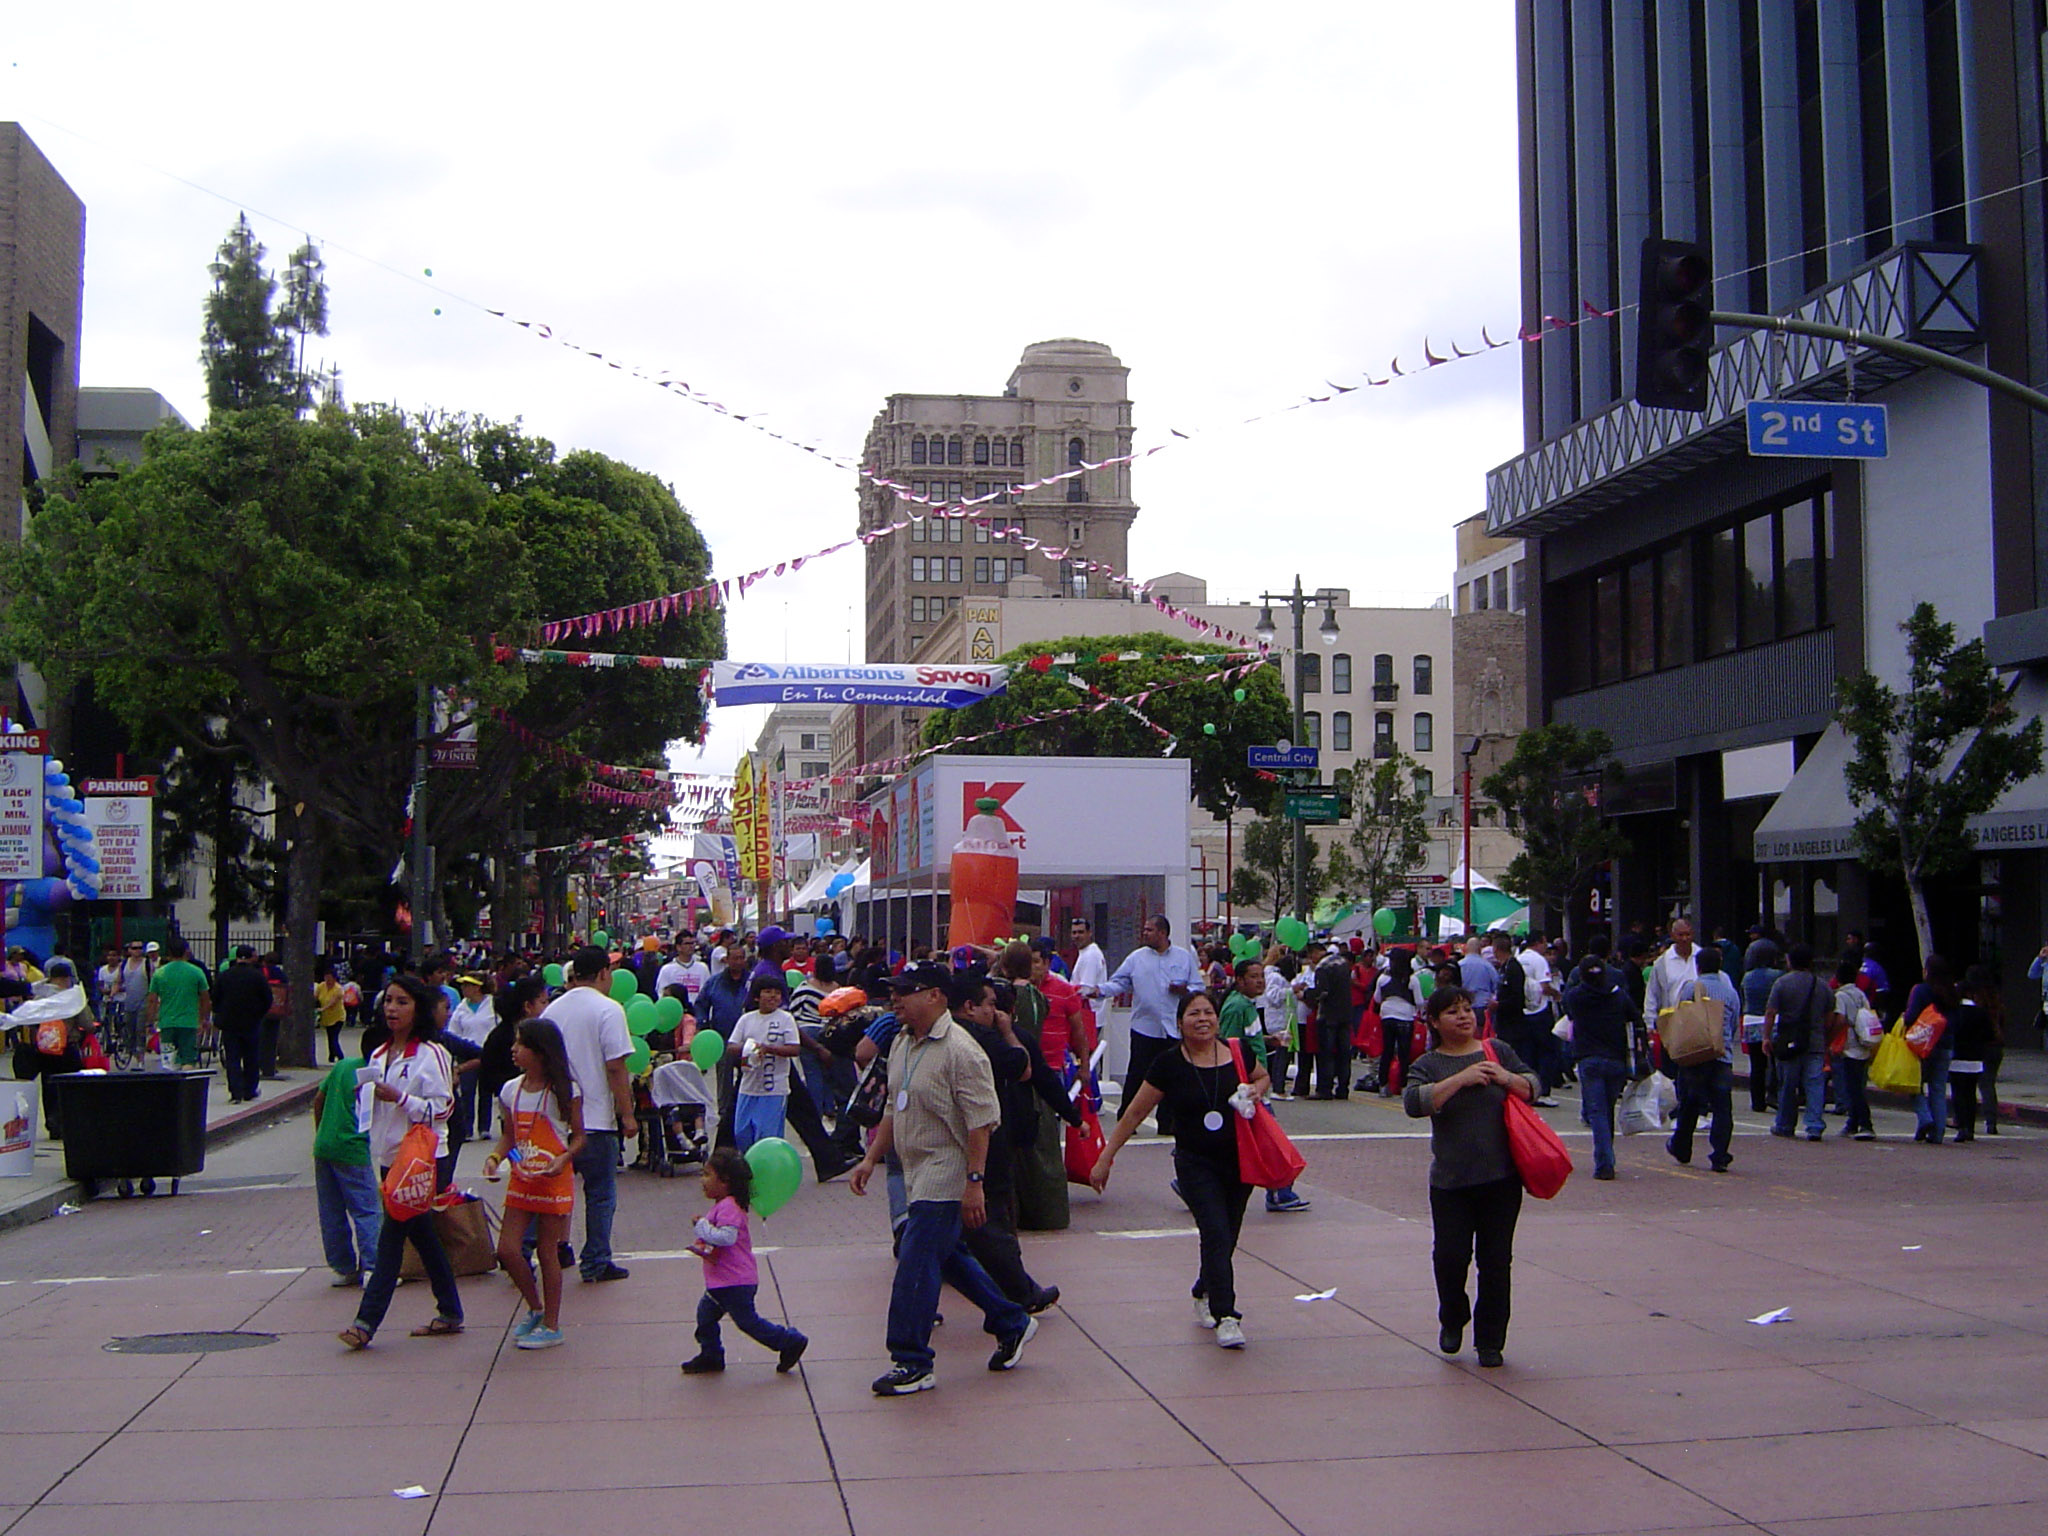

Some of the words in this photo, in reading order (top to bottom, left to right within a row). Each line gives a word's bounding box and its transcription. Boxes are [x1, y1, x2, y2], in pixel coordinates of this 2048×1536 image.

[1761, 411, 1821, 445] 2nd
[1837, 417, 1875, 445] St
[967, 608, 998, 623] PAN
[782, 666, 905, 680] Albertsons
[782, 687, 808, 701] En
[814, 688, 836, 701] Tu
[841, 687, 949, 704] Comunidad
[0, 735, 40, 748] KING
[1254, 753, 1290, 762] Central
[1294, 753, 1314, 764] City
[3, 788, 32, 797] EACH
[88, 780, 149, 792] PARKING
[11, 800, 24, 808] 15
[963, 781, 1026, 833] K
[4, 810, 30, 819] MIN.
[1982, 825, 2035, 843] ANGELES
[103, 847, 134, 856] PARKING
[1773, 842, 1790, 857] LOS
[1792, 840, 1832, 856] ANGELES
[101, 857, 136, 865] VIOLATION
[101, 884, 114, 893] ARK
[763, 1021, 784, 1091] abrcro
